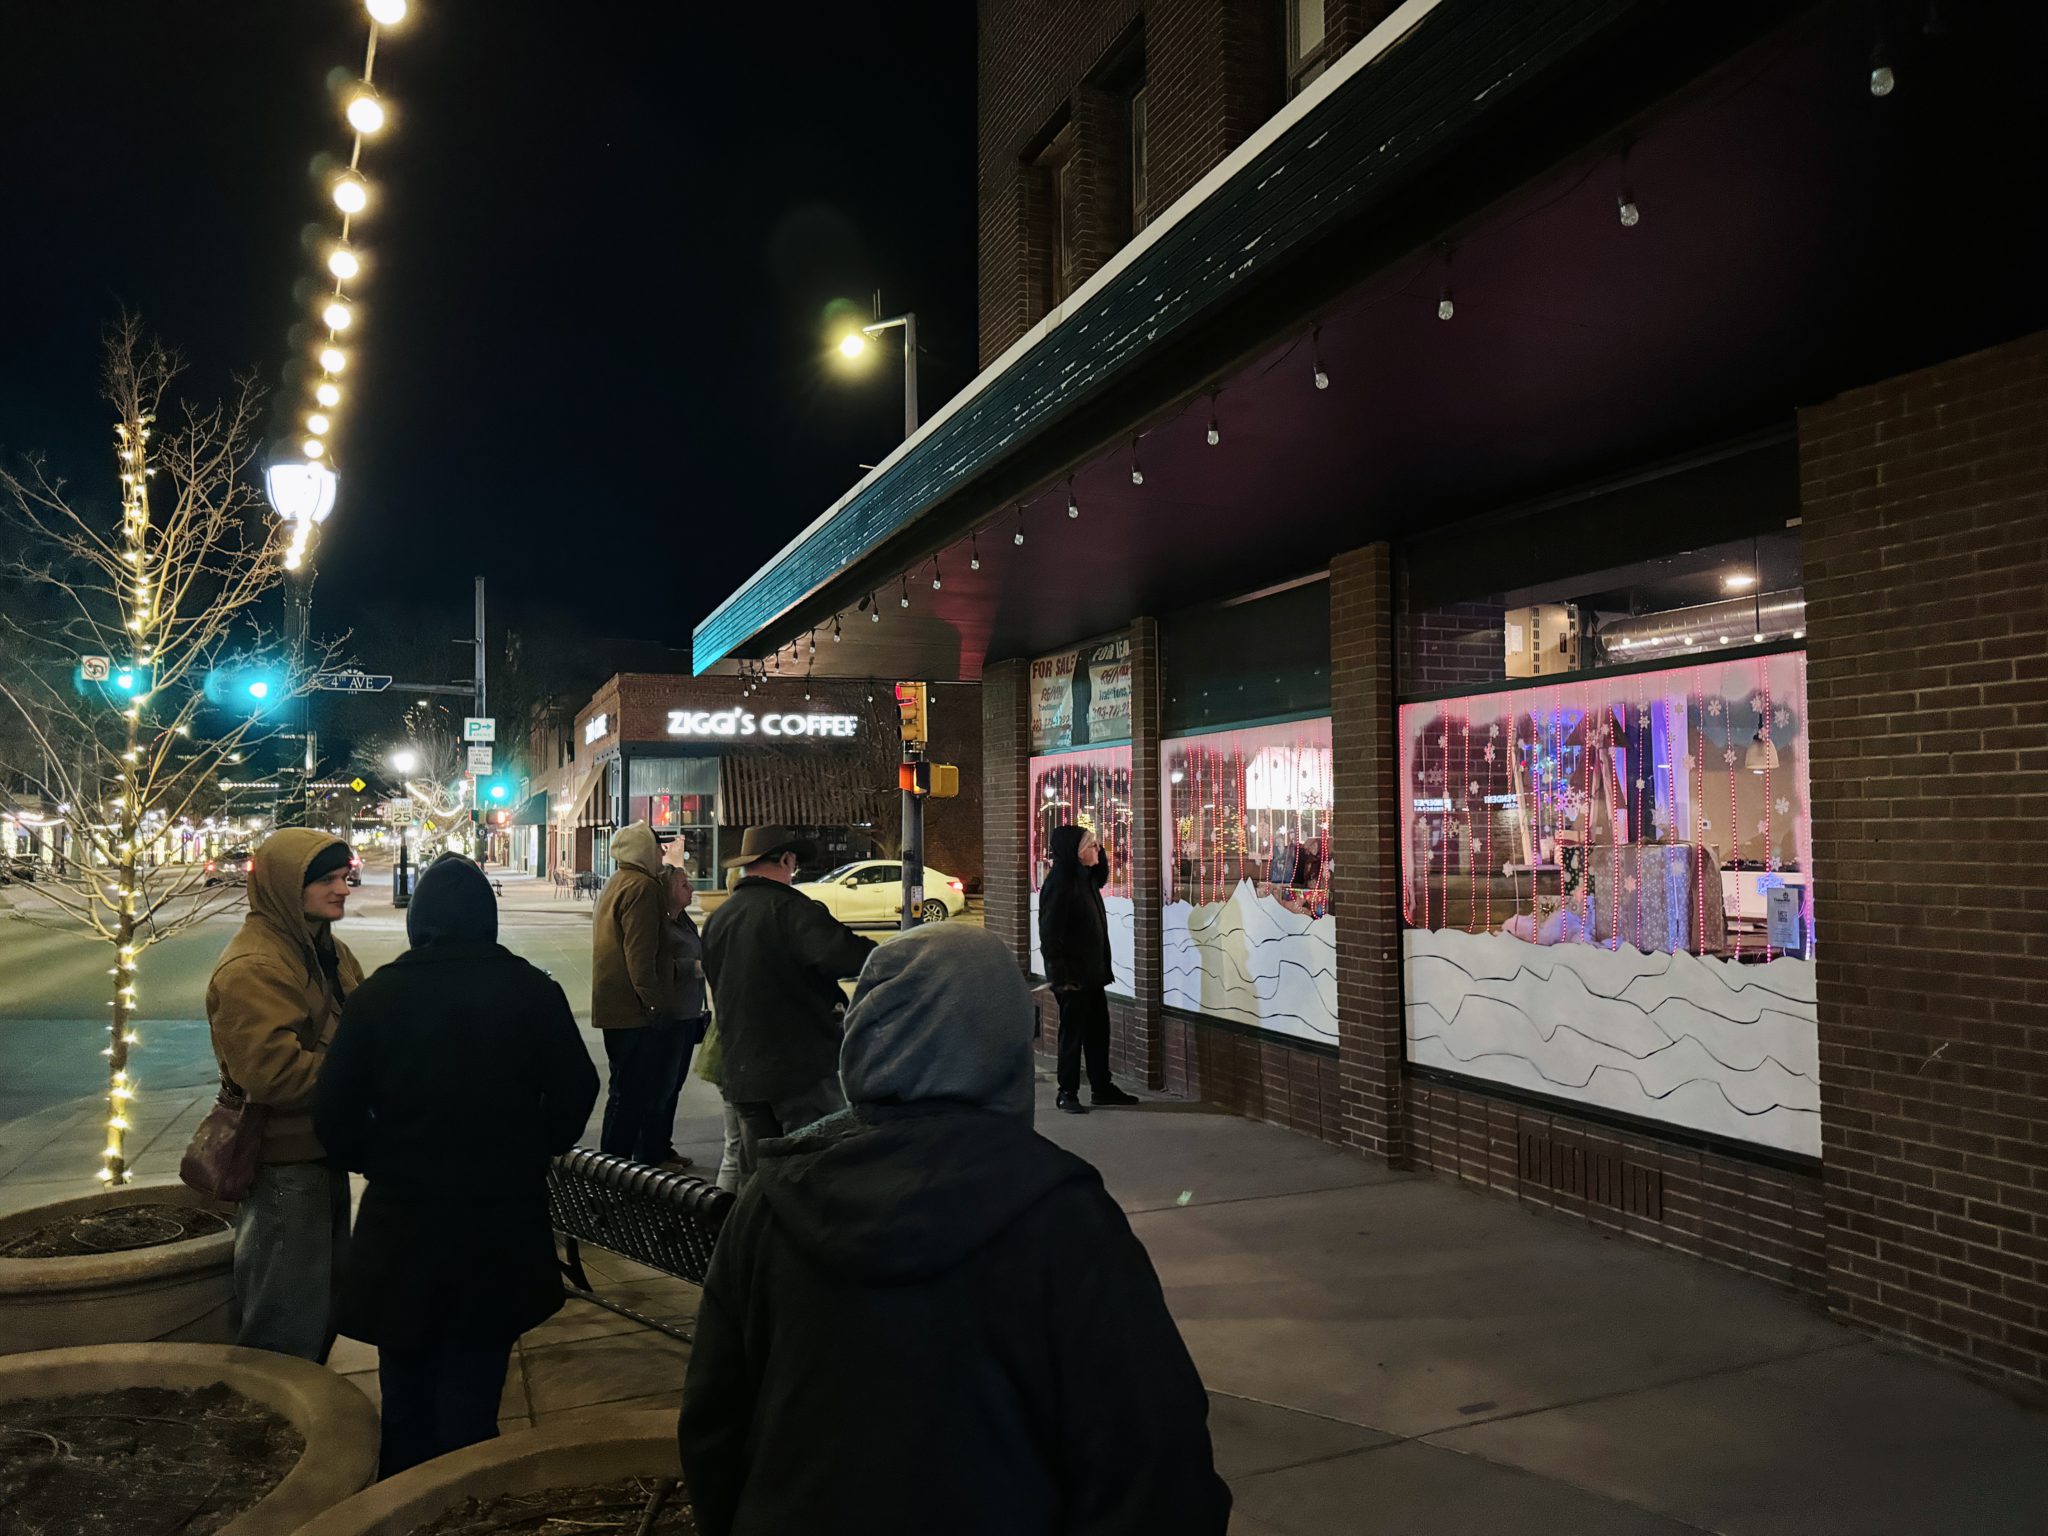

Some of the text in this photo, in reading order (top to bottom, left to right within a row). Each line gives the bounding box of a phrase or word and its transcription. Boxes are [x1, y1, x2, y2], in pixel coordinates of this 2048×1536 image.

[1092, 639, 1130, 662] FOR LEA
[1032, 660, 1053, 679] FOR
[331, 676, 373, 688] 4TH AVE
[760, 714, 858, 737] COFFEE
[394, 812, 411, 823] 25
